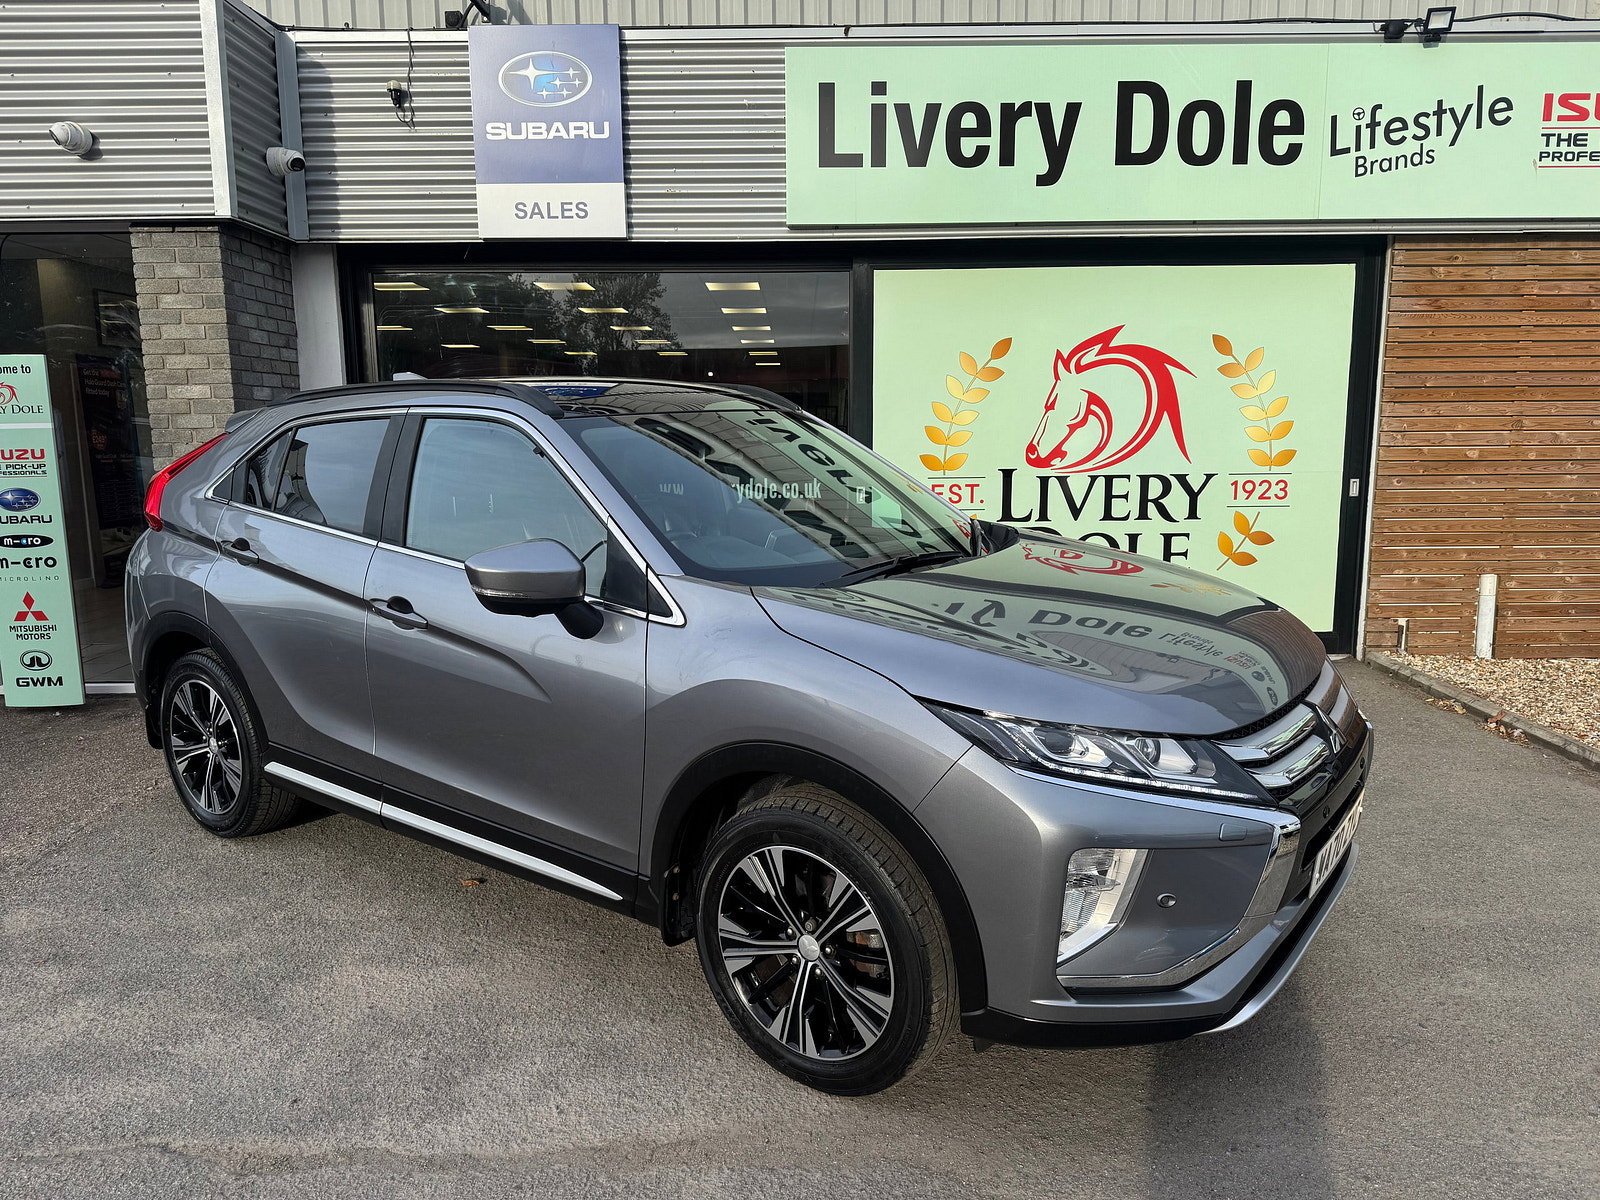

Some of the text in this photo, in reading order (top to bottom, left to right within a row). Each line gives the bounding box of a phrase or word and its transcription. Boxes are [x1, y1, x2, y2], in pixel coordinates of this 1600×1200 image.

[1542, 93, 1600, 122] IS
[1329, 84, 1514, 157] Lifestyle
[485, 121, 610, 140] SUBARU
[818, 79, 1305, 187] Livery Dole
[1540, 132, 1589, 148] THE
[1354, 142, 1436, 178] Brands
[514, 201, 589, 220] SALES
[20, 364, 31, 374] to
[11, 404, 44, 414] DOLE
[997, 467, 1218, 523] LIVERY
[1230, 479, 1289, 501] 1923
[9, 624, 58, 632] MITSUBISHI
[16, 676, 64, 688] GWM
